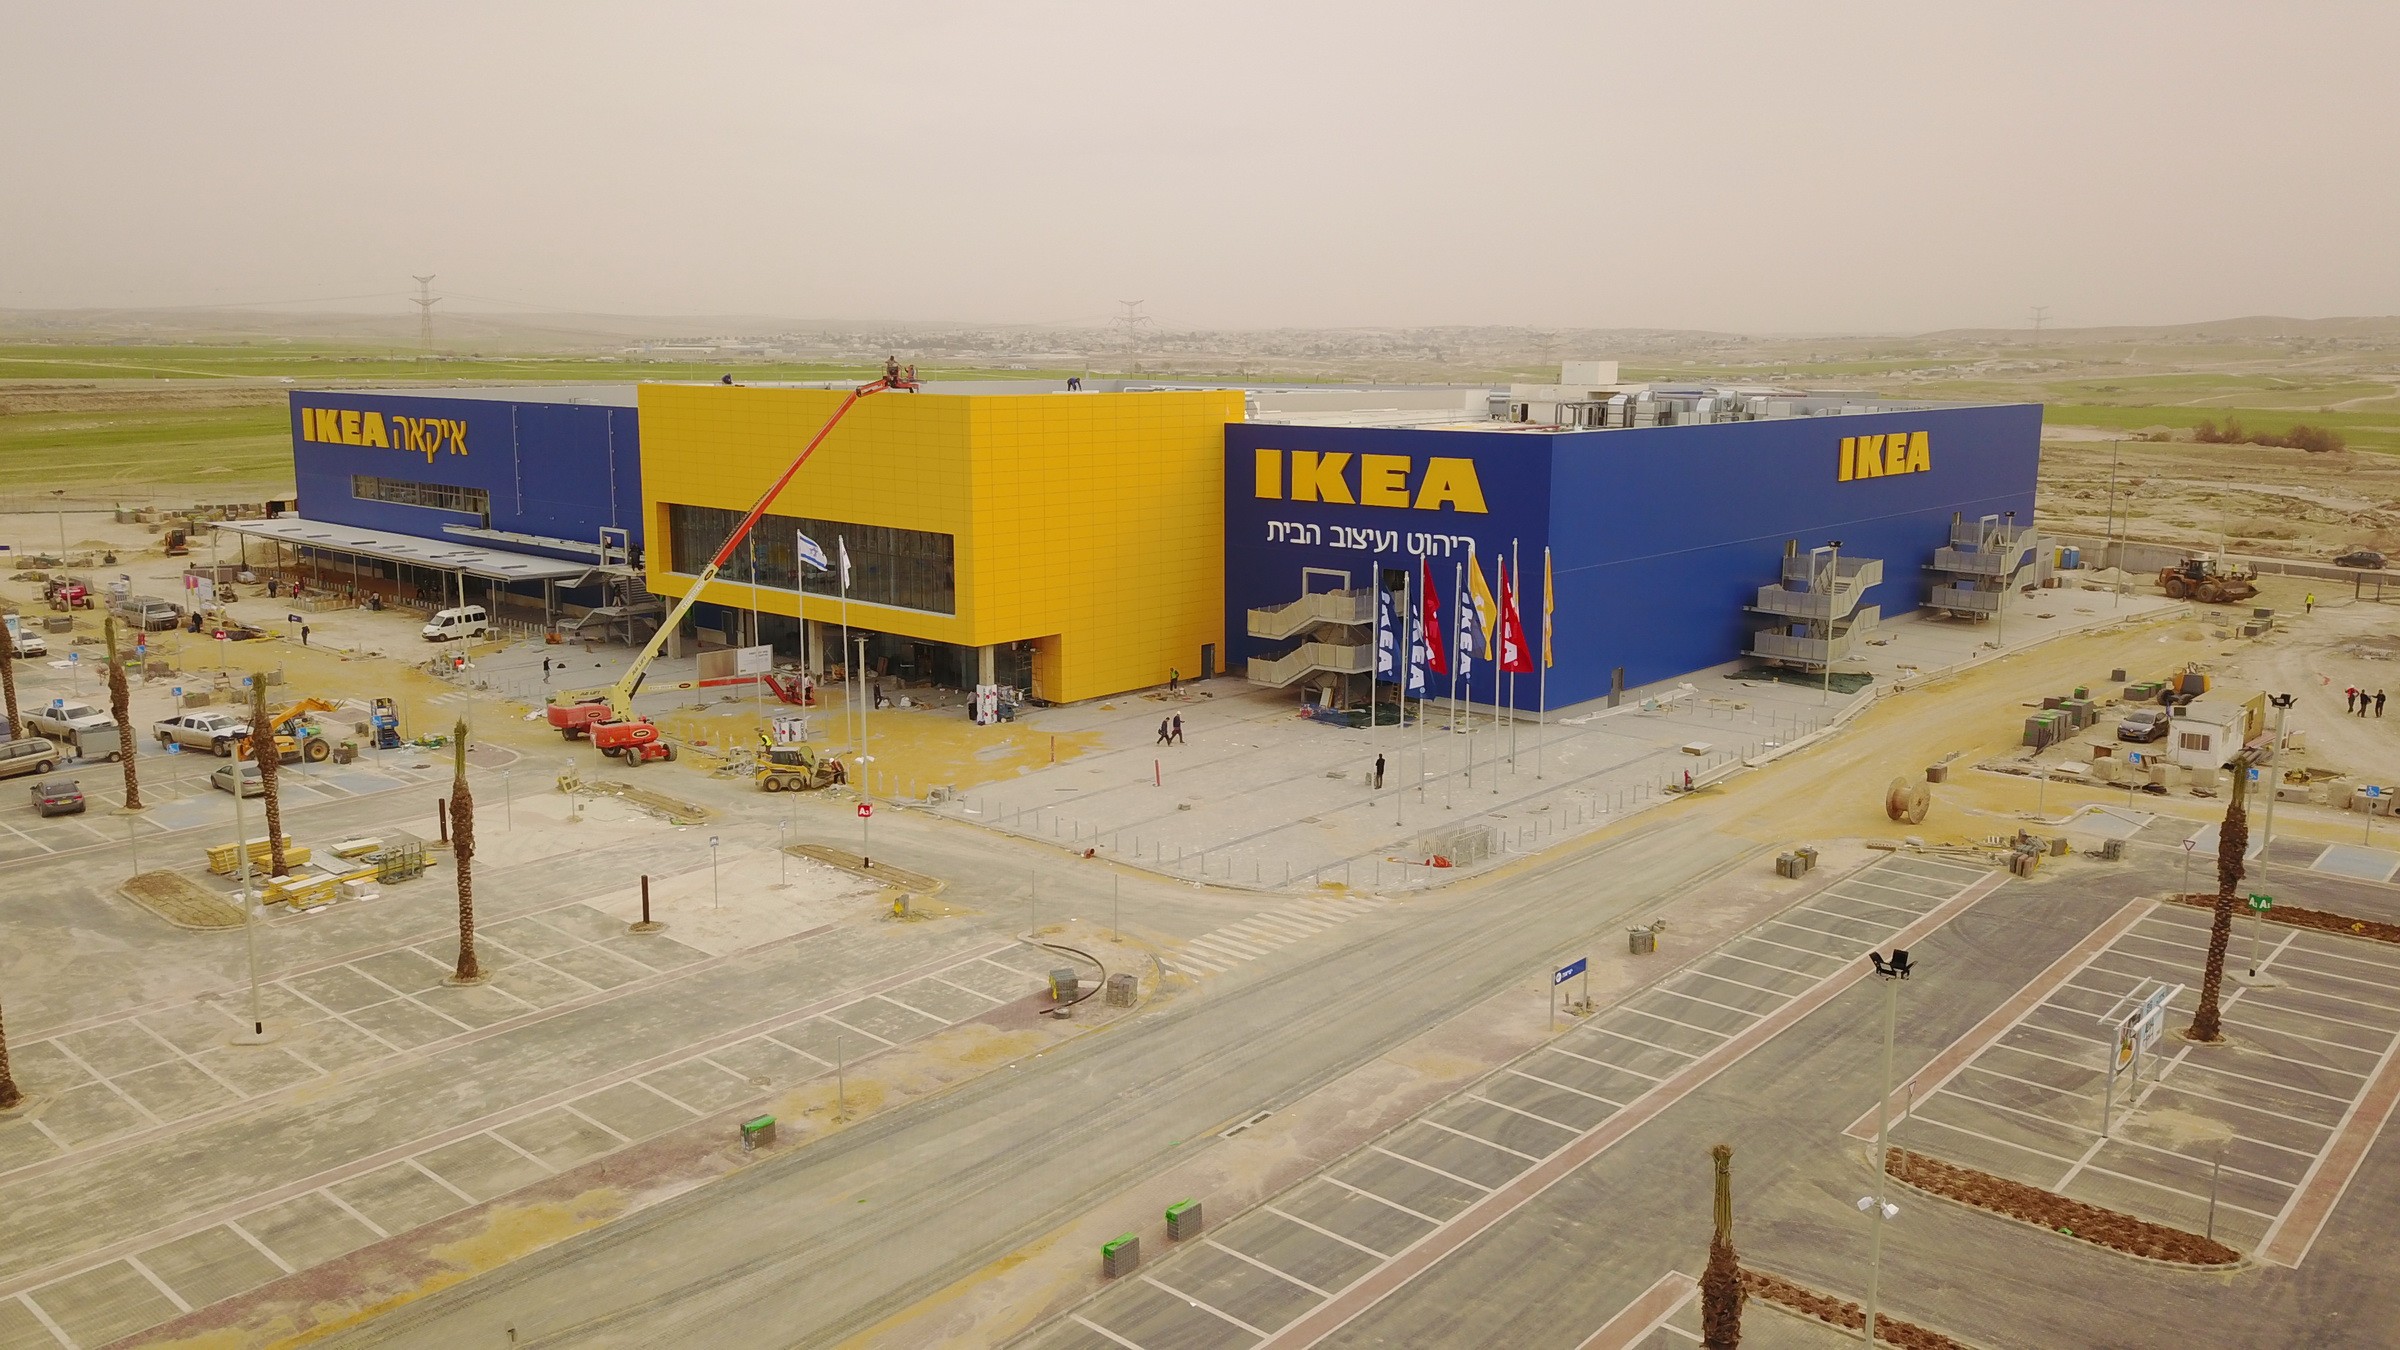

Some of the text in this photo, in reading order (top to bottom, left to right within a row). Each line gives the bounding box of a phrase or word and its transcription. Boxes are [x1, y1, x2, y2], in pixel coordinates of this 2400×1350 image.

[302, 407, 390, 448] IKEA
[392, 415, 468, 464] איקאה
[1838, 430, 1931, 482] IKEA
[1254, 448, 1489, 514] IKEA
[1266, 520, 1476, 557] ריהוט ועיצוב הבית
